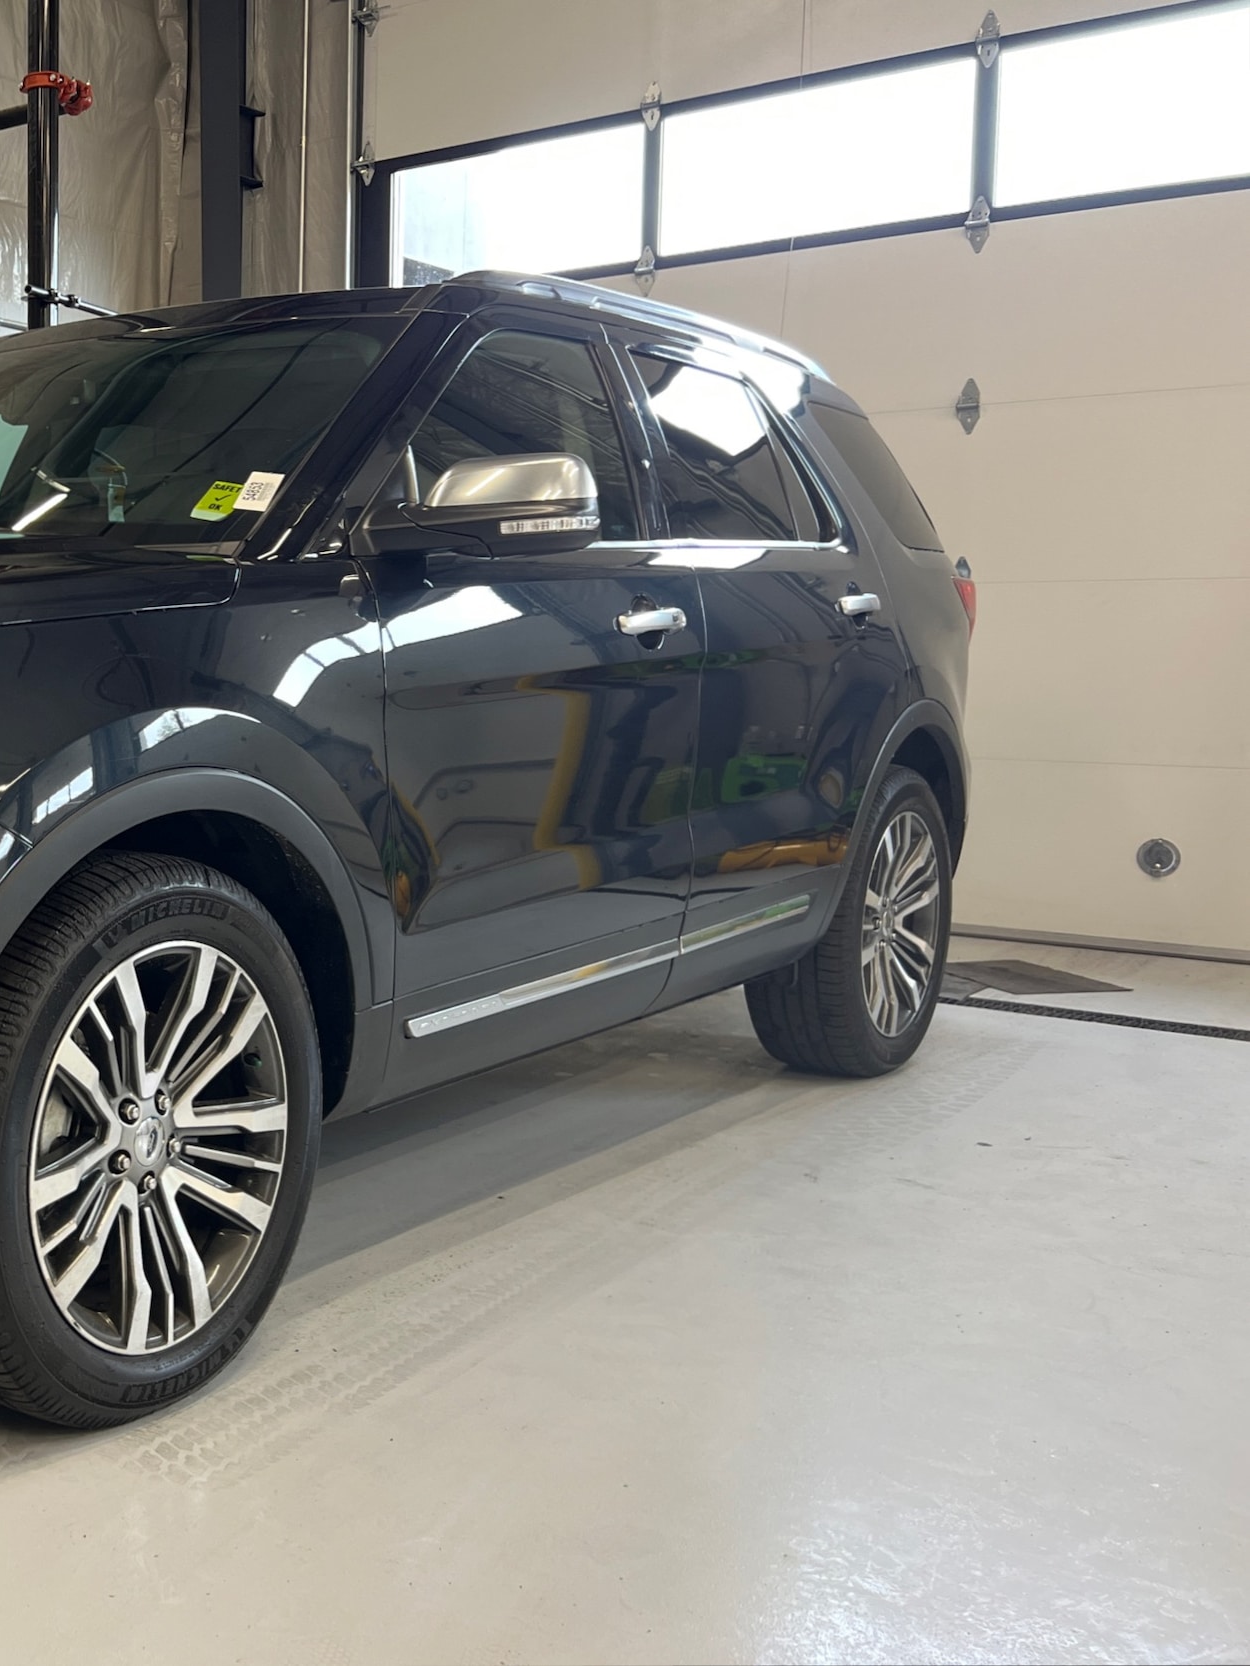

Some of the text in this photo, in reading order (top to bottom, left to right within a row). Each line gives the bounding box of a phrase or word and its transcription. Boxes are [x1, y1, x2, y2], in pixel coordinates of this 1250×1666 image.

[212, 483, 241, 493] SAFET
[208, 503, 223, 511] OK
[130, 899, 228, 931] MICHELIN
